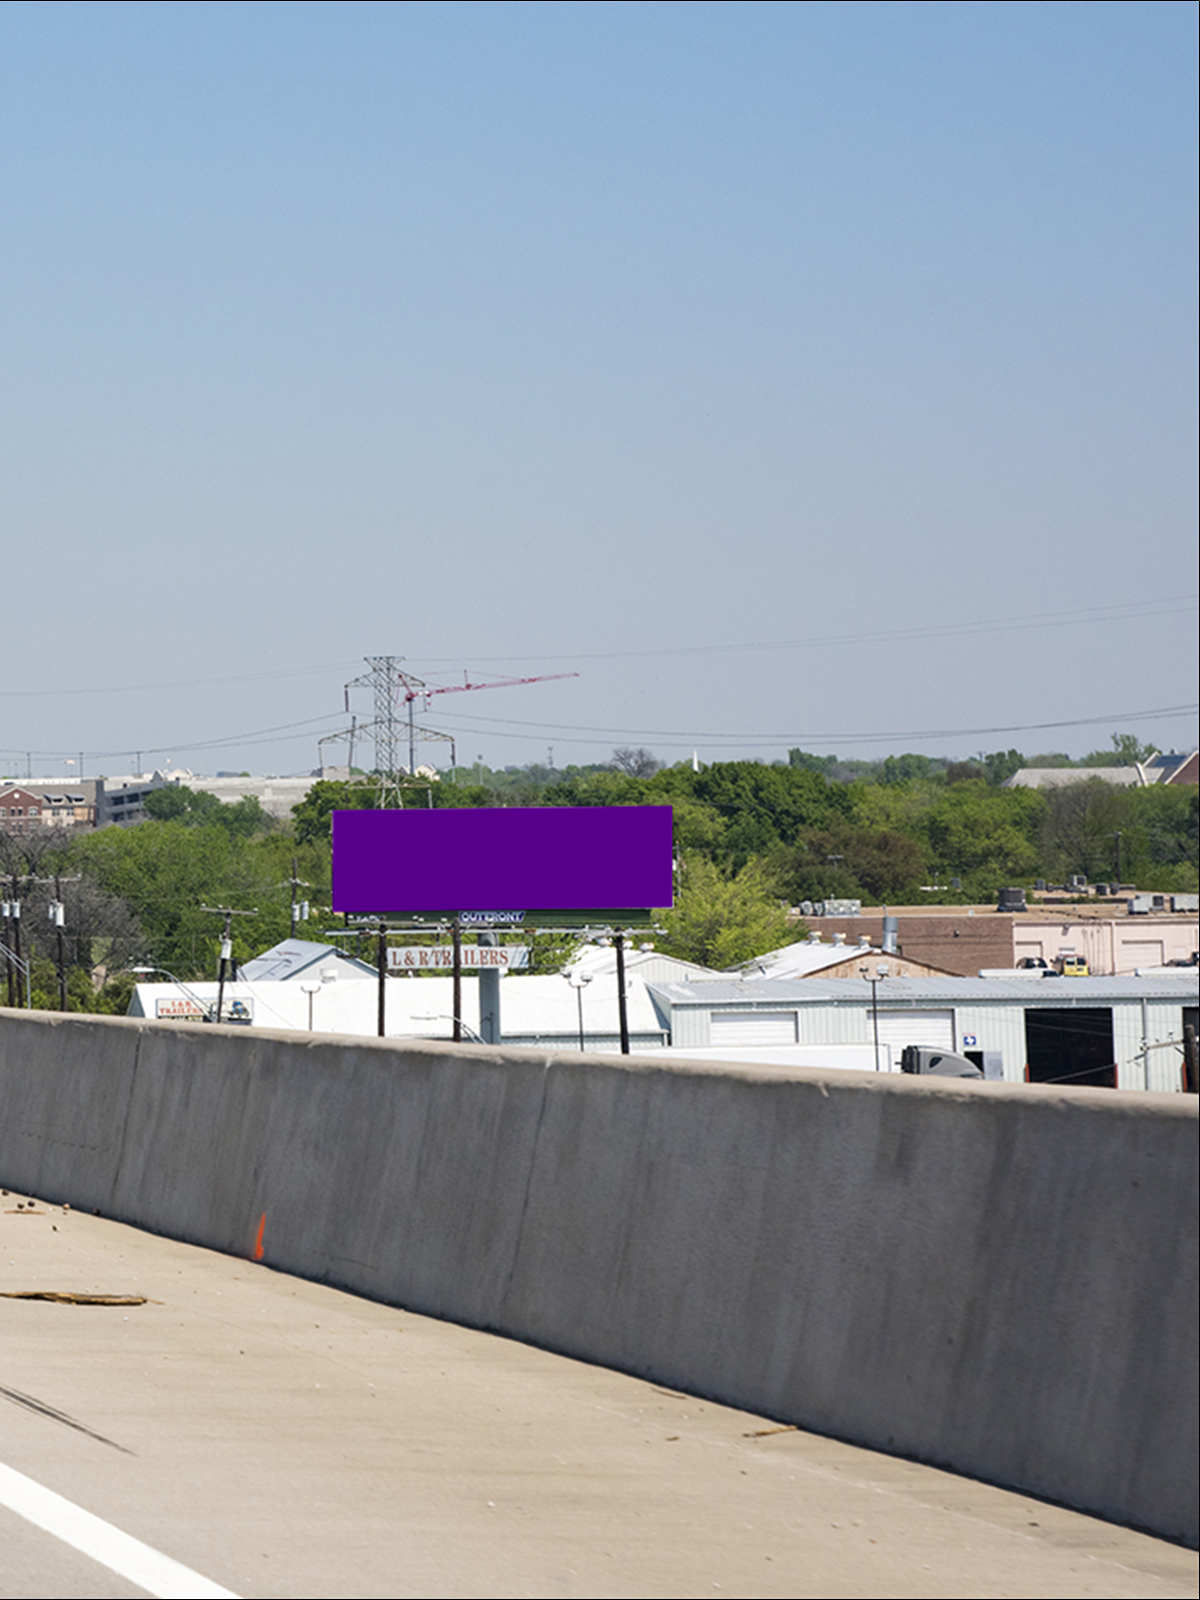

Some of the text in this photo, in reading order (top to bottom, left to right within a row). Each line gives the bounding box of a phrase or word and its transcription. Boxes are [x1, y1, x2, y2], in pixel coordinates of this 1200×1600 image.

[392, 949, 509, 966] L & R TRILERS
